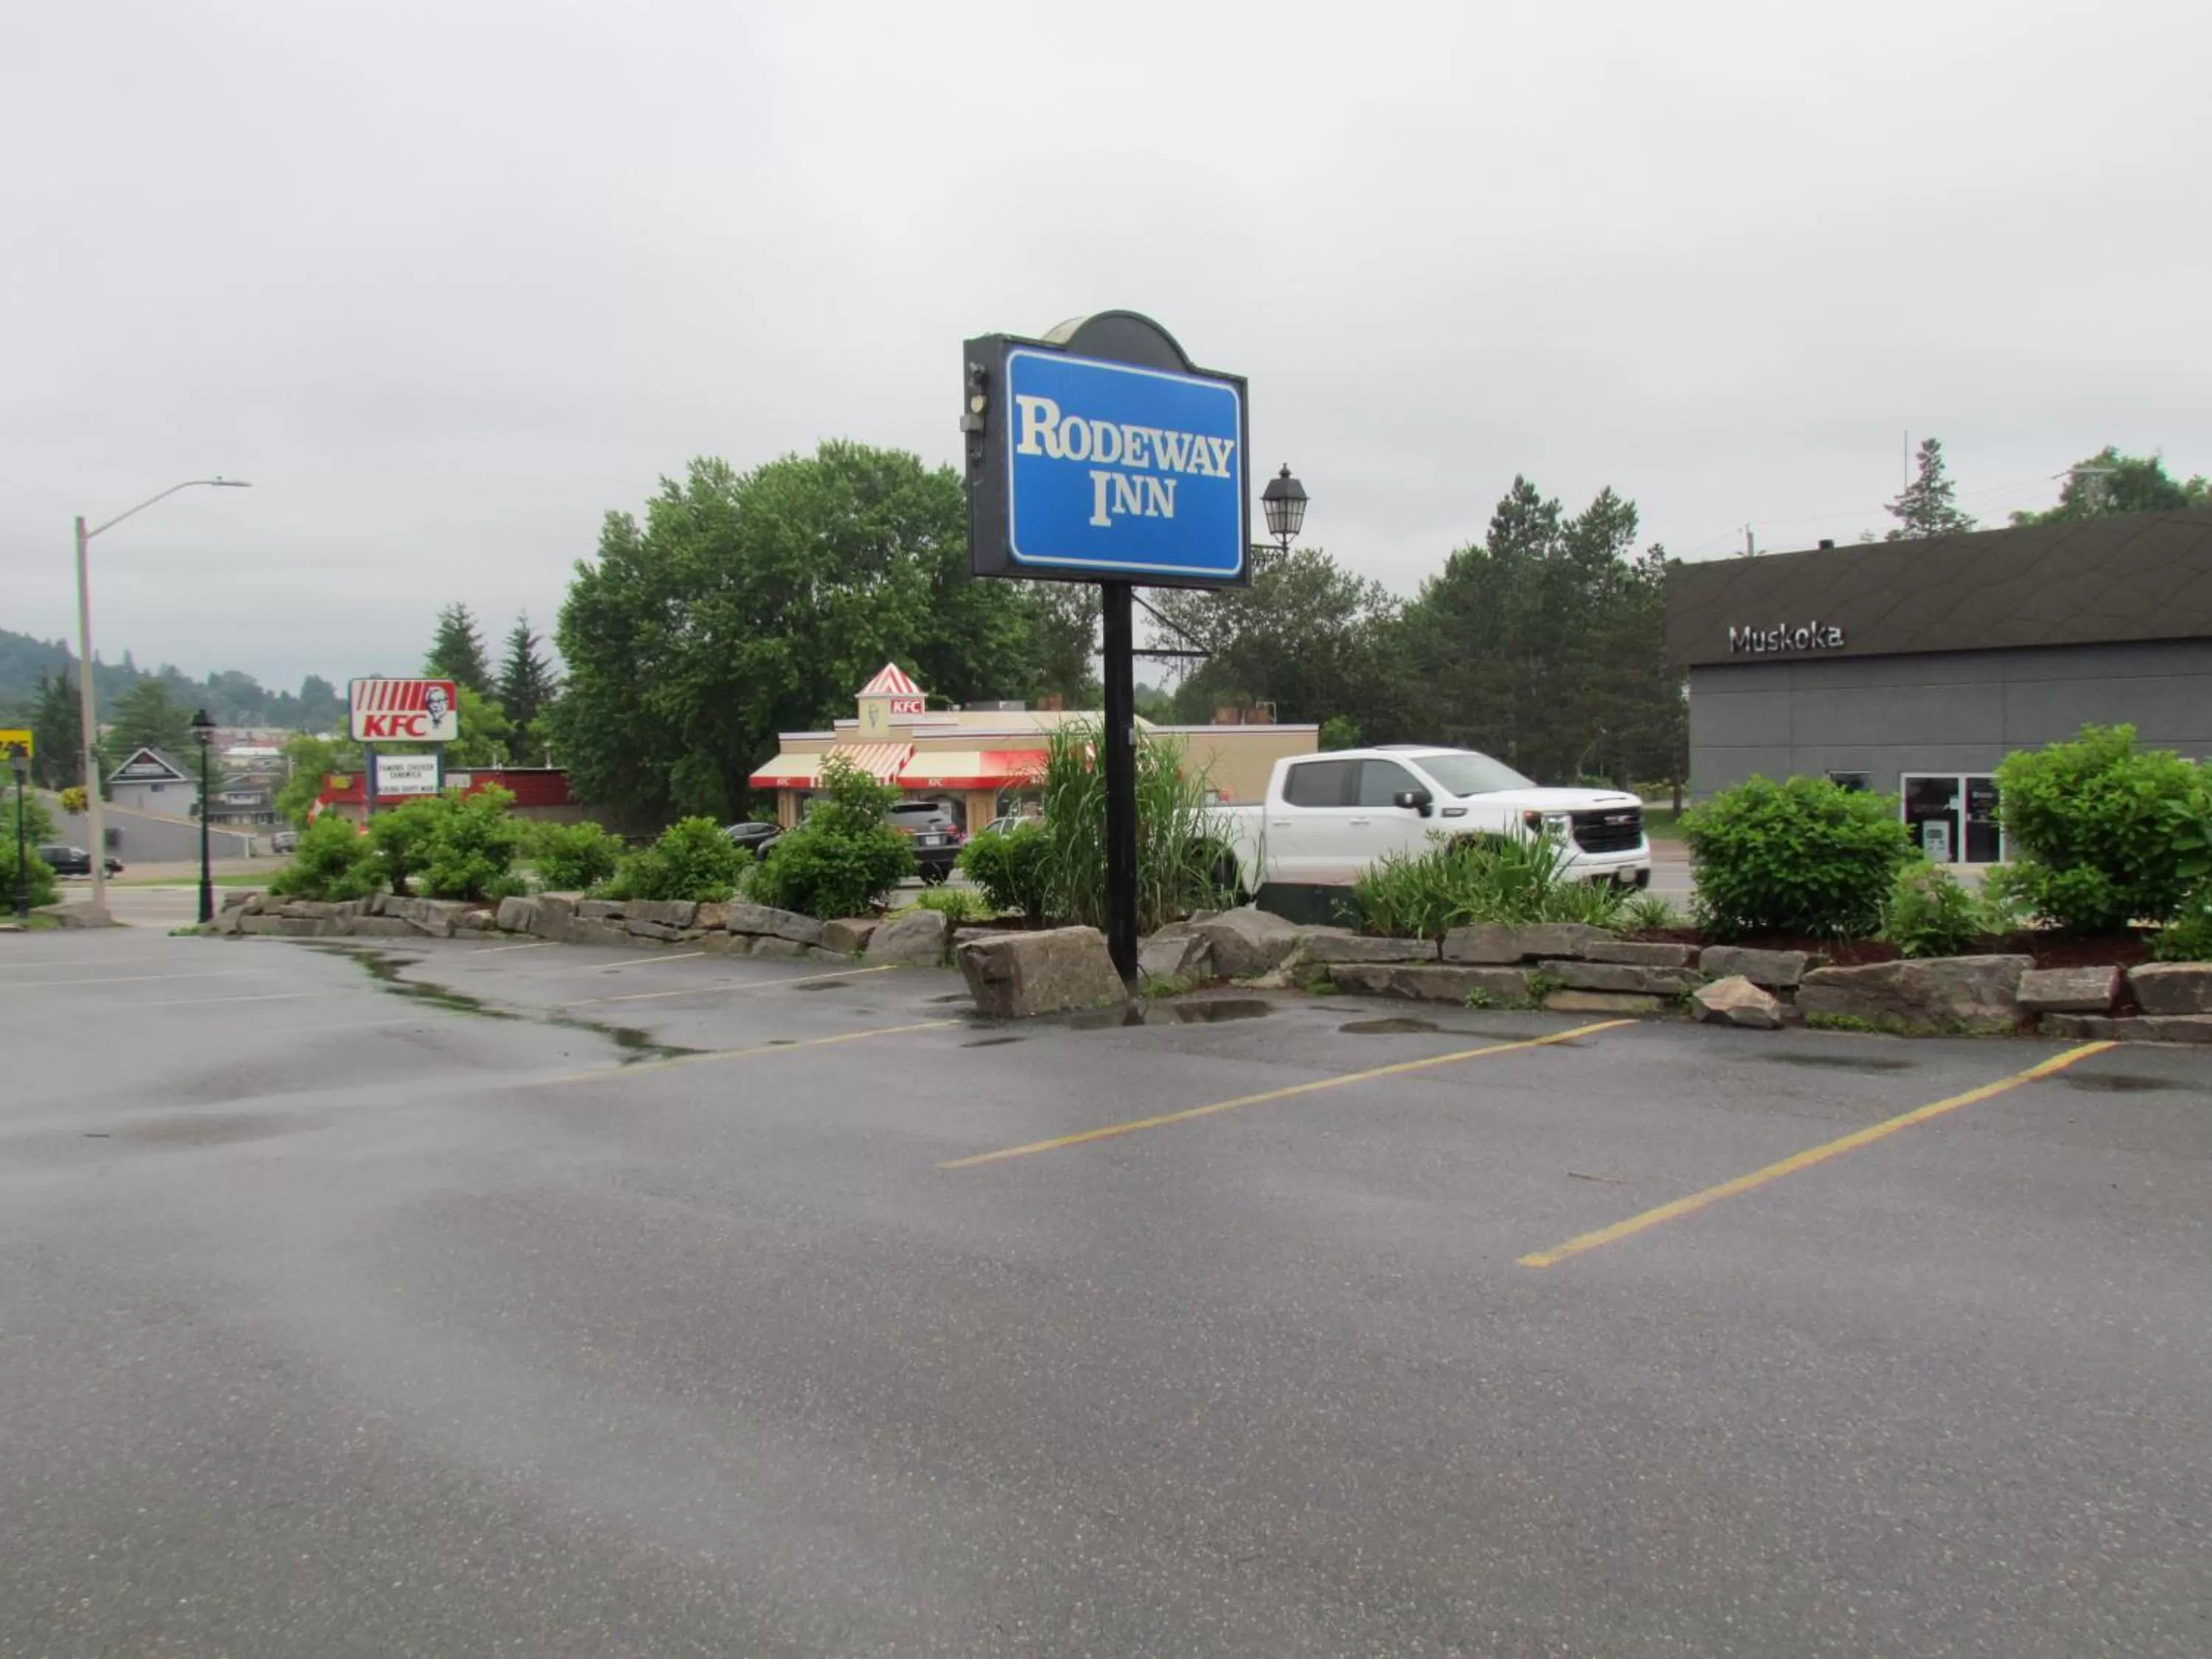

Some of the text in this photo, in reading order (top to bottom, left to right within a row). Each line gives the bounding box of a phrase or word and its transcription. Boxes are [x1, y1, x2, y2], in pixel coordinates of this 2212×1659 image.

[1015, 394, 1234, 478] RODEWAY
[1089, 470, 1177, 527] INN
[1729, 620, 1844, 652] Muskoka
[893, 700, 921, 713] KFC
[363, 714, 428, 737] KFC
